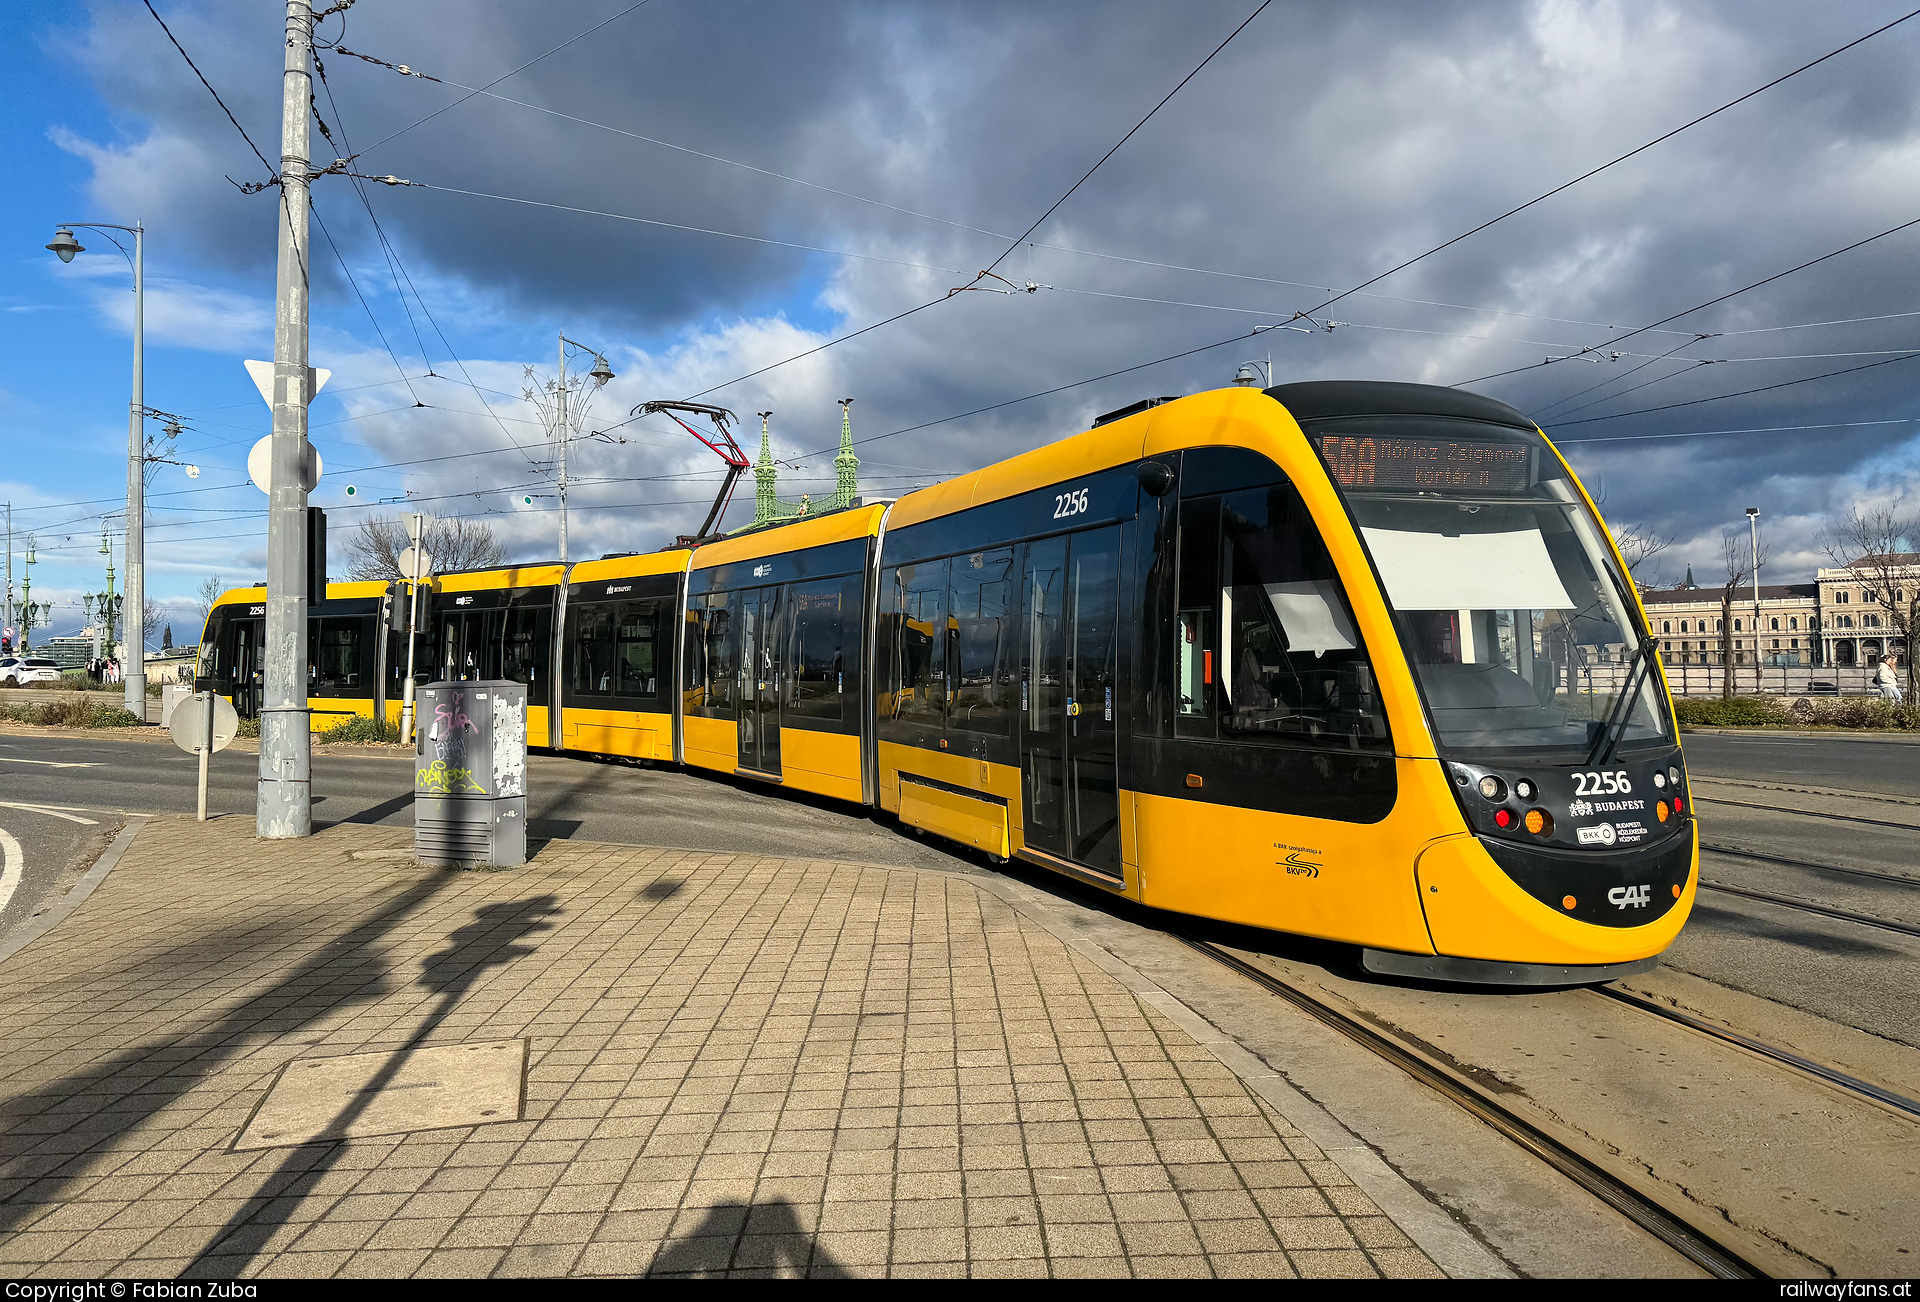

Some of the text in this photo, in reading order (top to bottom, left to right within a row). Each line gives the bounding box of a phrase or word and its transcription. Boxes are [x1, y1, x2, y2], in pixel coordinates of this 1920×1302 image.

[1381, 439, 1438, 460] Móricz
[1054, 488, 1089, 519] 2256
[249, 606, 265, 615] 2256
[1571, 771, 1632, 796] 2256
[1594, 800, 1645, 812] BUDAPEST
[1583, 832, 1600, 840] BKK
[1608, 885, 1651, 910] CAF
